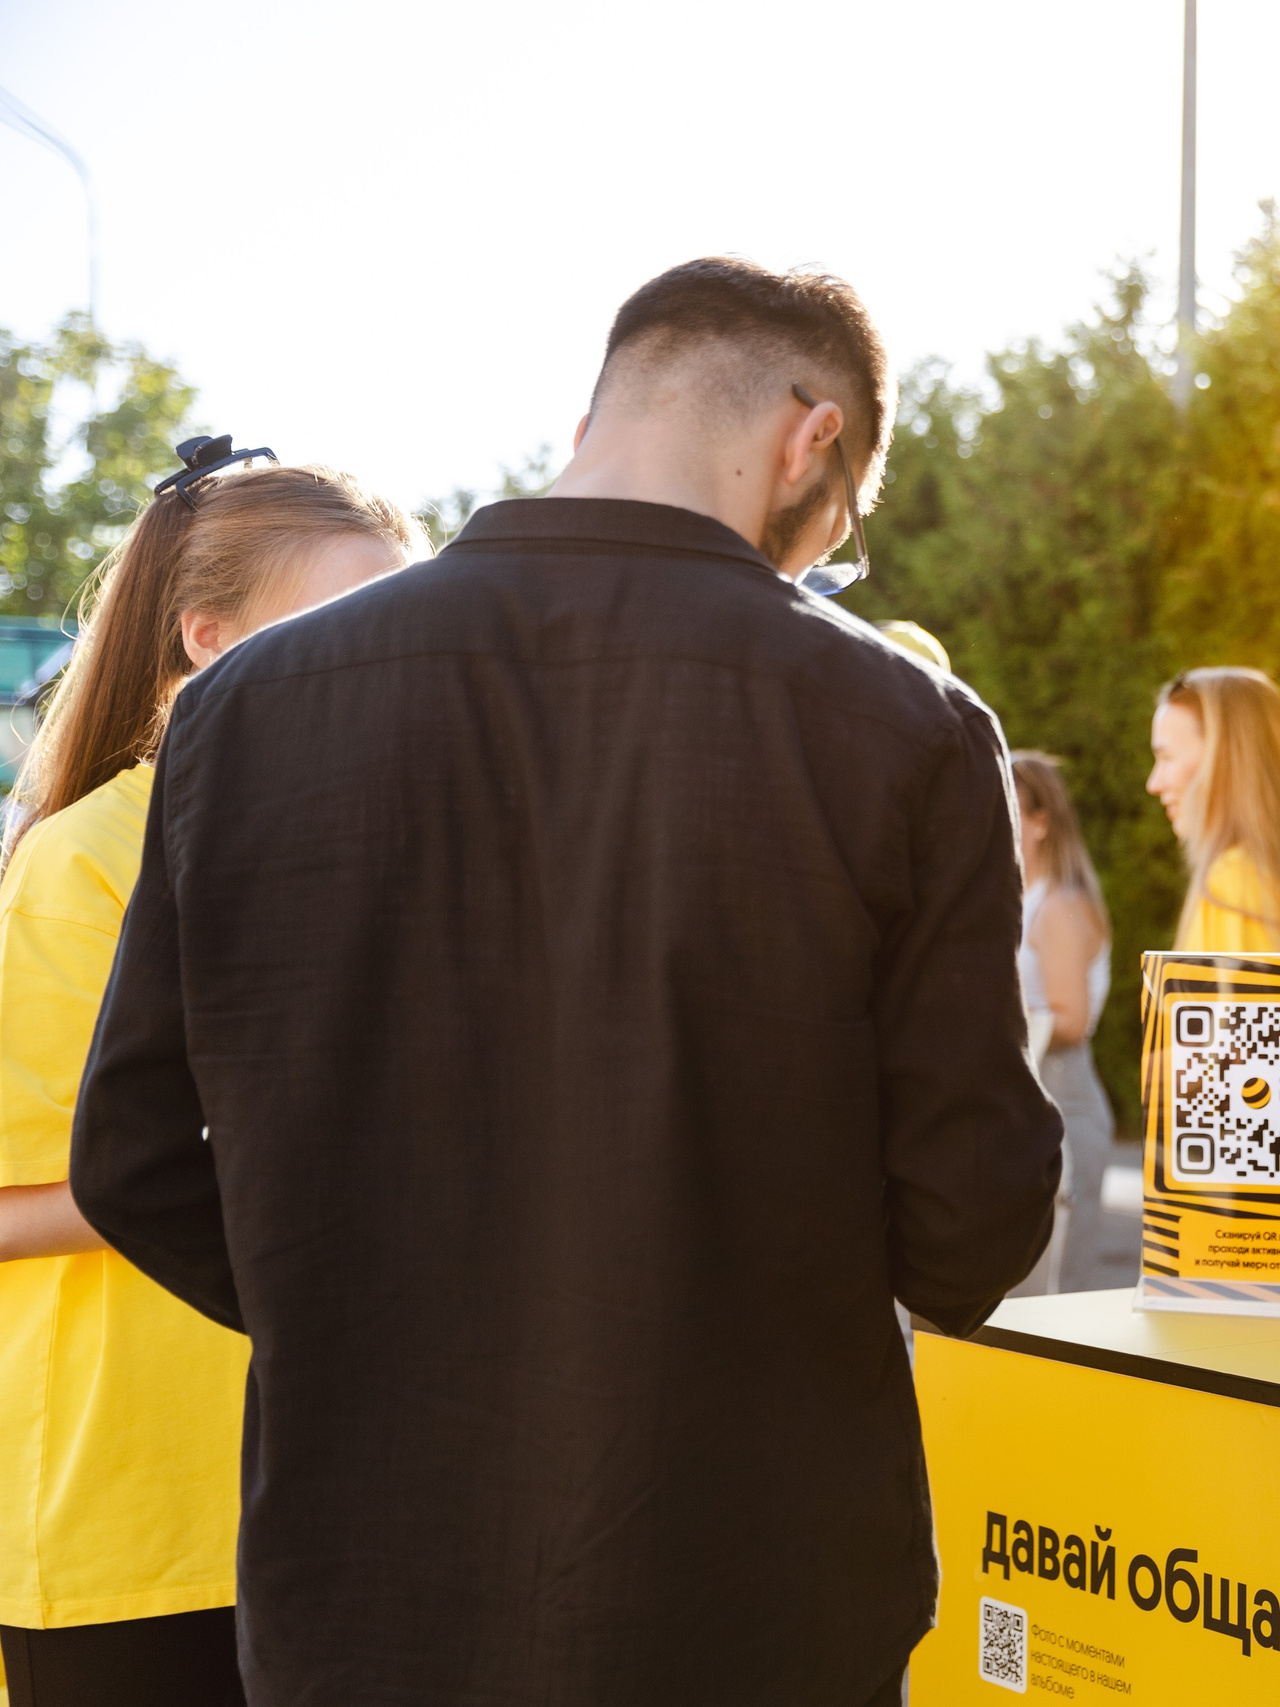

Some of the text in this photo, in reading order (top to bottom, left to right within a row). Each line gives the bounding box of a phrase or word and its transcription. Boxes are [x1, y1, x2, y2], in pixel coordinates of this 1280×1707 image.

[1208, 1244, 1250, 1256] проходи
[1215, 1229, 1261, 1243] Сканируй
[1262, 1231, 1277, 1242] QR
[1201, 1257, 1240, 1271] получай
[1242, 1260, 1268, 1271] мерч
[1269, 1261, 1280, 1270] от
[982, 1510, 1116, 1601] давай
[1030, 1623, 1126, 1669] Фото с моментами
[1030, 1650, 1132, 1695] настоящего в нашем
[1030, 1672, 1075, 1700] альбоме
